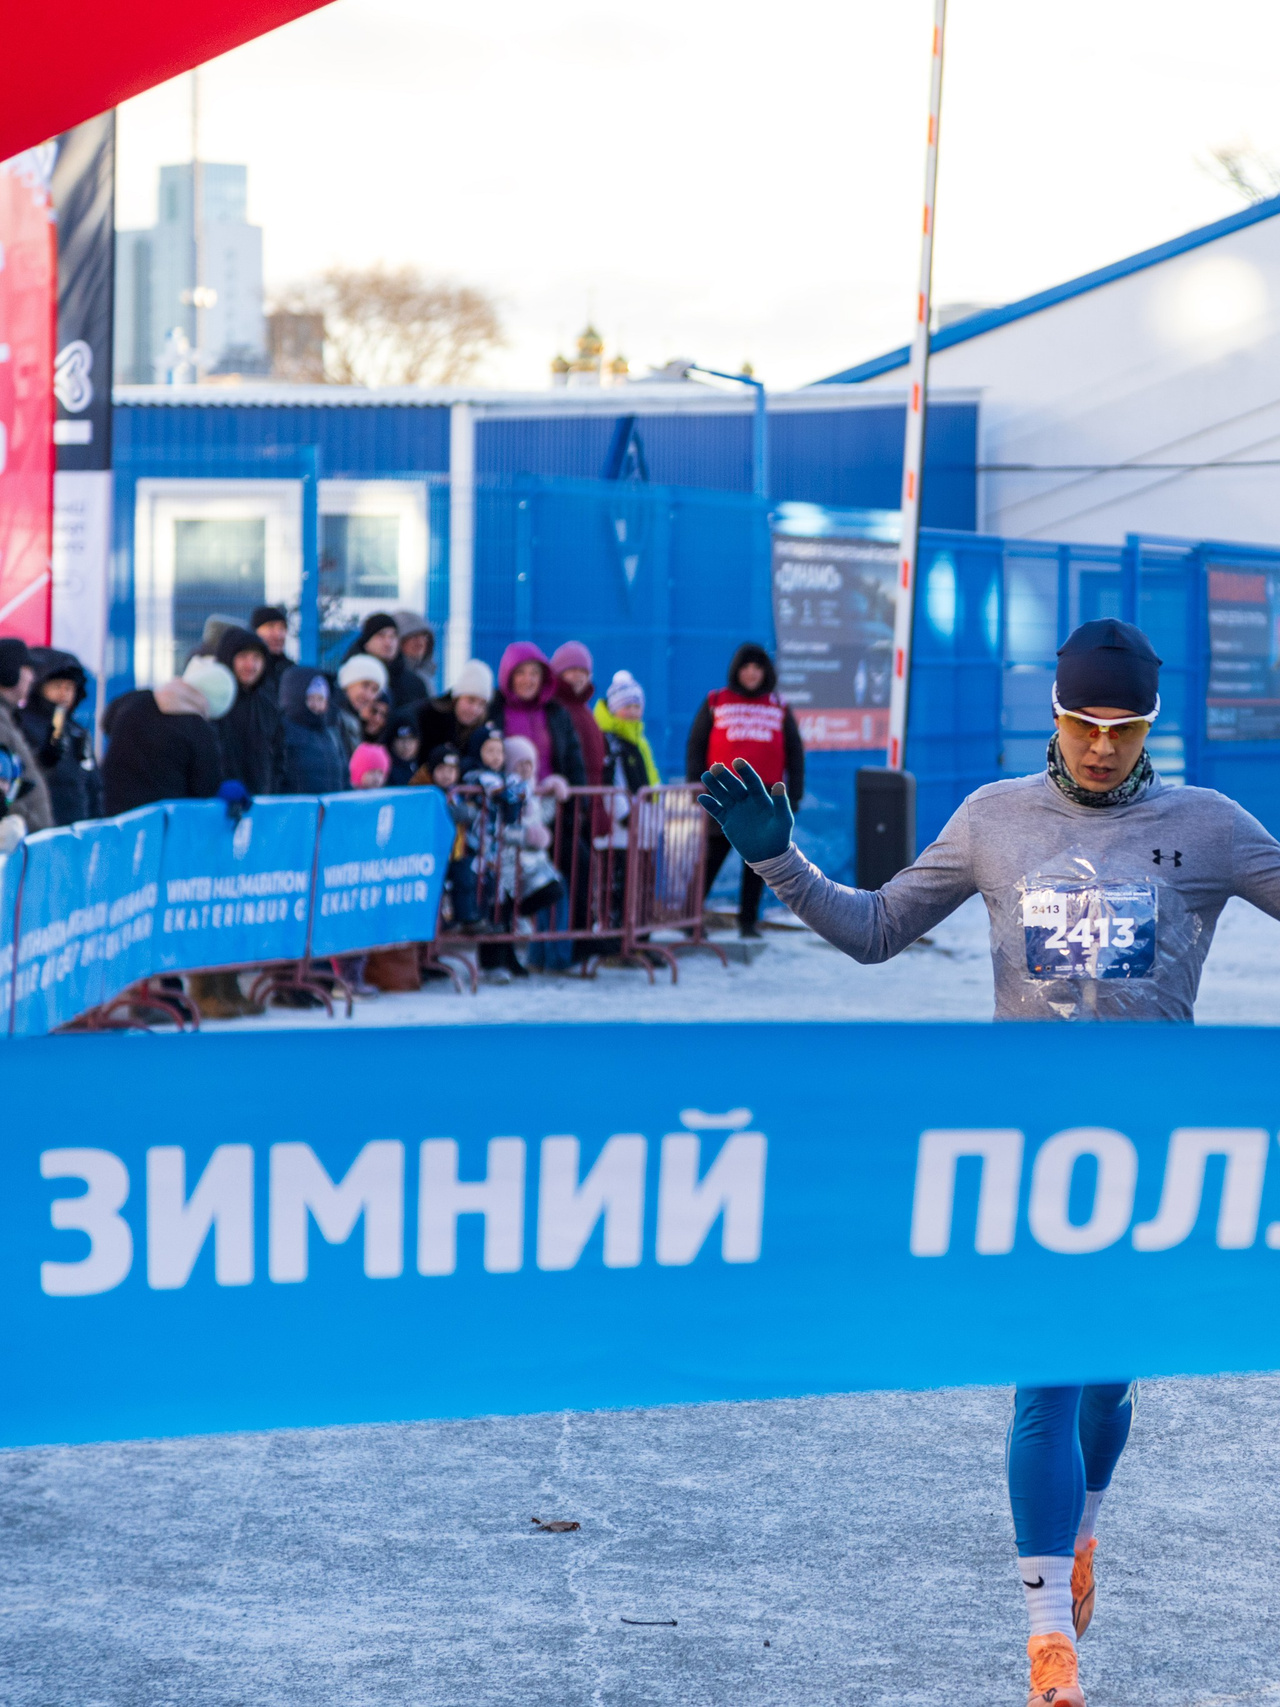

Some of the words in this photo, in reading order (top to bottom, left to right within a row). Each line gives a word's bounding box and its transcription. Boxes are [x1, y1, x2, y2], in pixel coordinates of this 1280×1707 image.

[1032, 904, 1060, 915] 2413
[1044, 917, 1135, 949] 2413
[40, 1107, 768, 1298] ЗИМНИЙ
